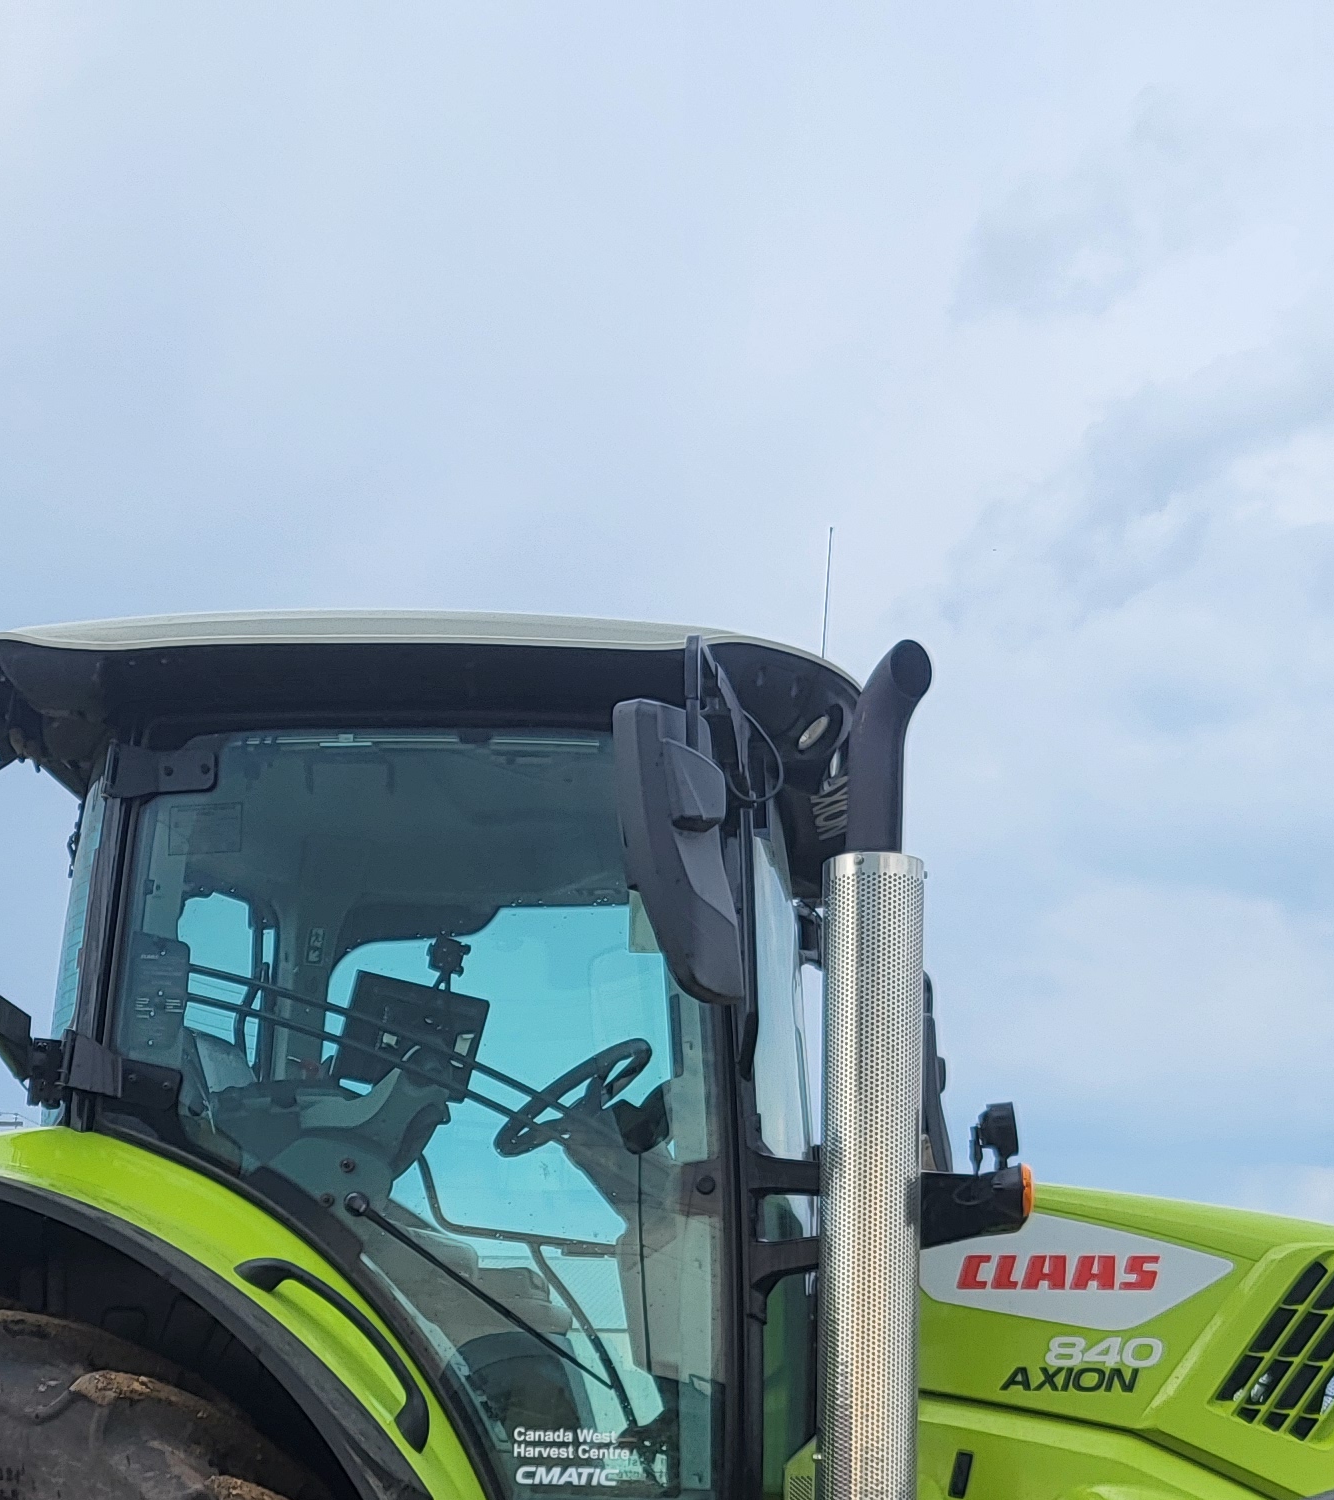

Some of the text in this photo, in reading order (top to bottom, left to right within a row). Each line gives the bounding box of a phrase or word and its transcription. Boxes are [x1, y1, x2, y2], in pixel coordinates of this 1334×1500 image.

[956, 1254, 1161, 1291] CLAAS
[1044, 1336, 1163, 1368] 840
[1000, 1366, 1140, 1393] AXION
[513, 1426, 617, 1443] Canada West
[513, 1442, 630, 1460] Harvest Centre
[515, 1465, 619, 1487] CMATIC
